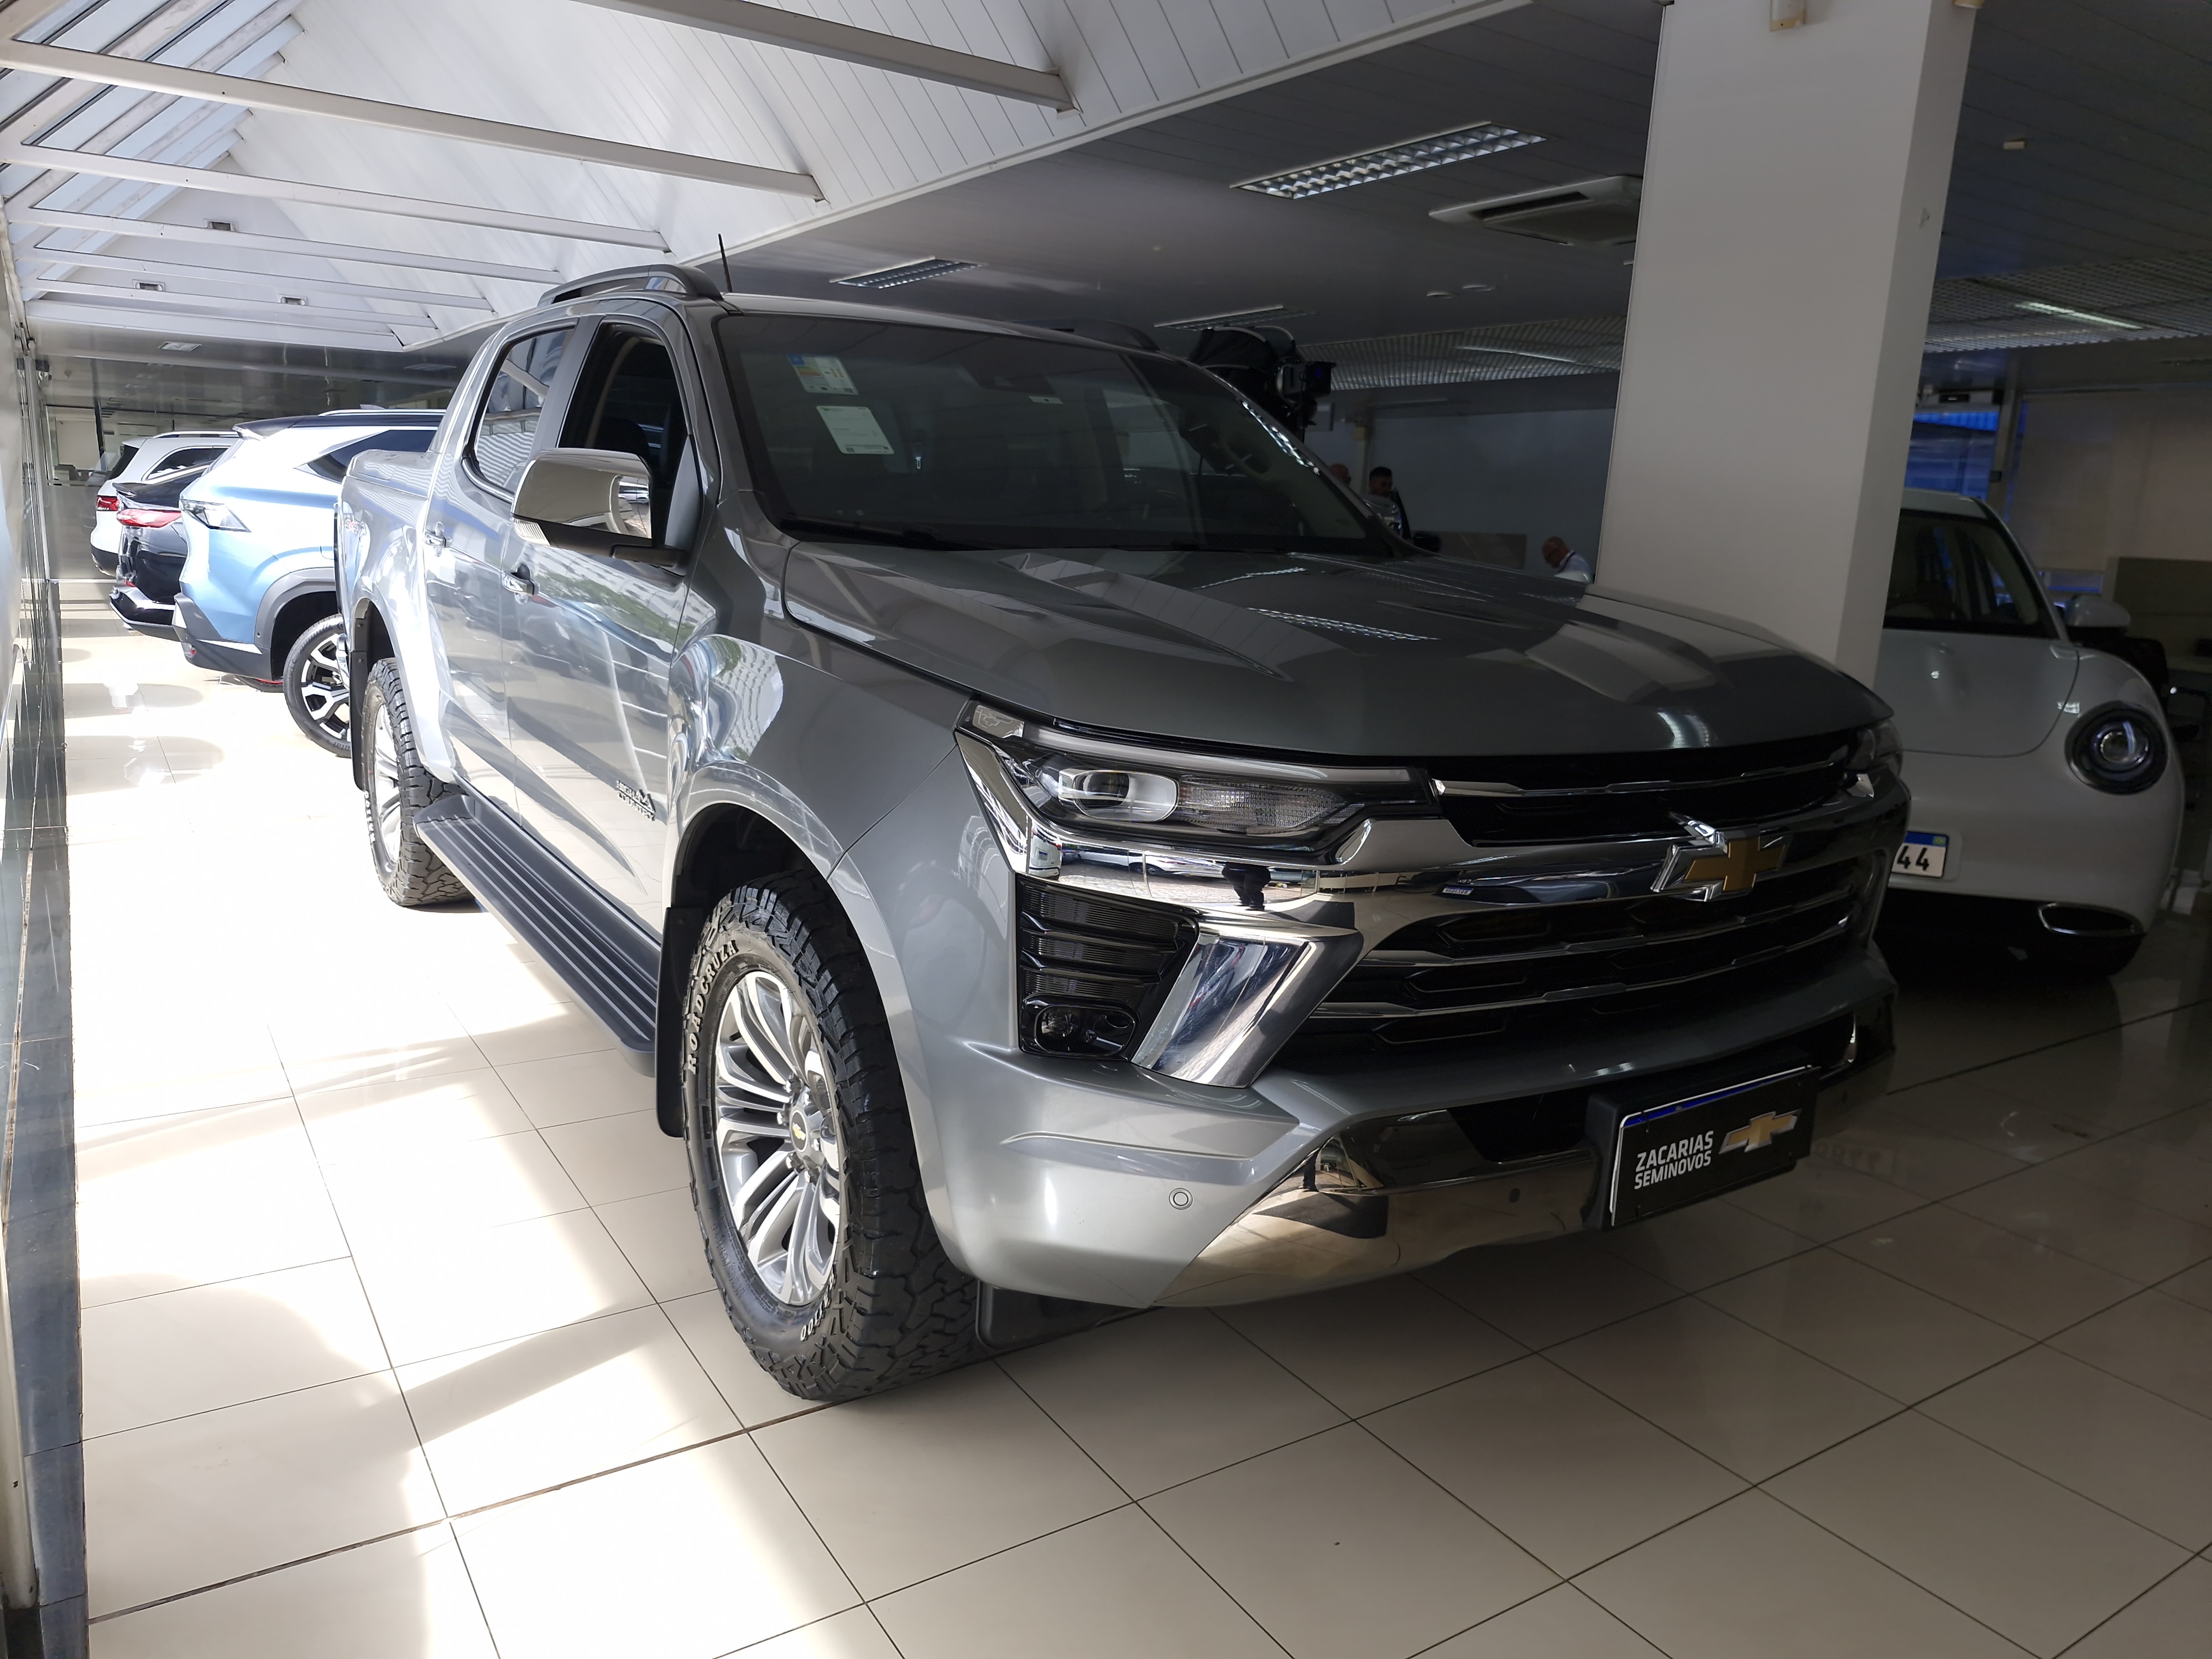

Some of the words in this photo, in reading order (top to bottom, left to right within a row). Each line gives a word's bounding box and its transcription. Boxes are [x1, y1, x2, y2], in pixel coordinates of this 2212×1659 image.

[688, 940, 739, 1074] ROADCRUZA
[1634, 1150, 1712, 1190] SEMINOVOS
[1635, 1130, 1714, 1172] ZACARIAS
